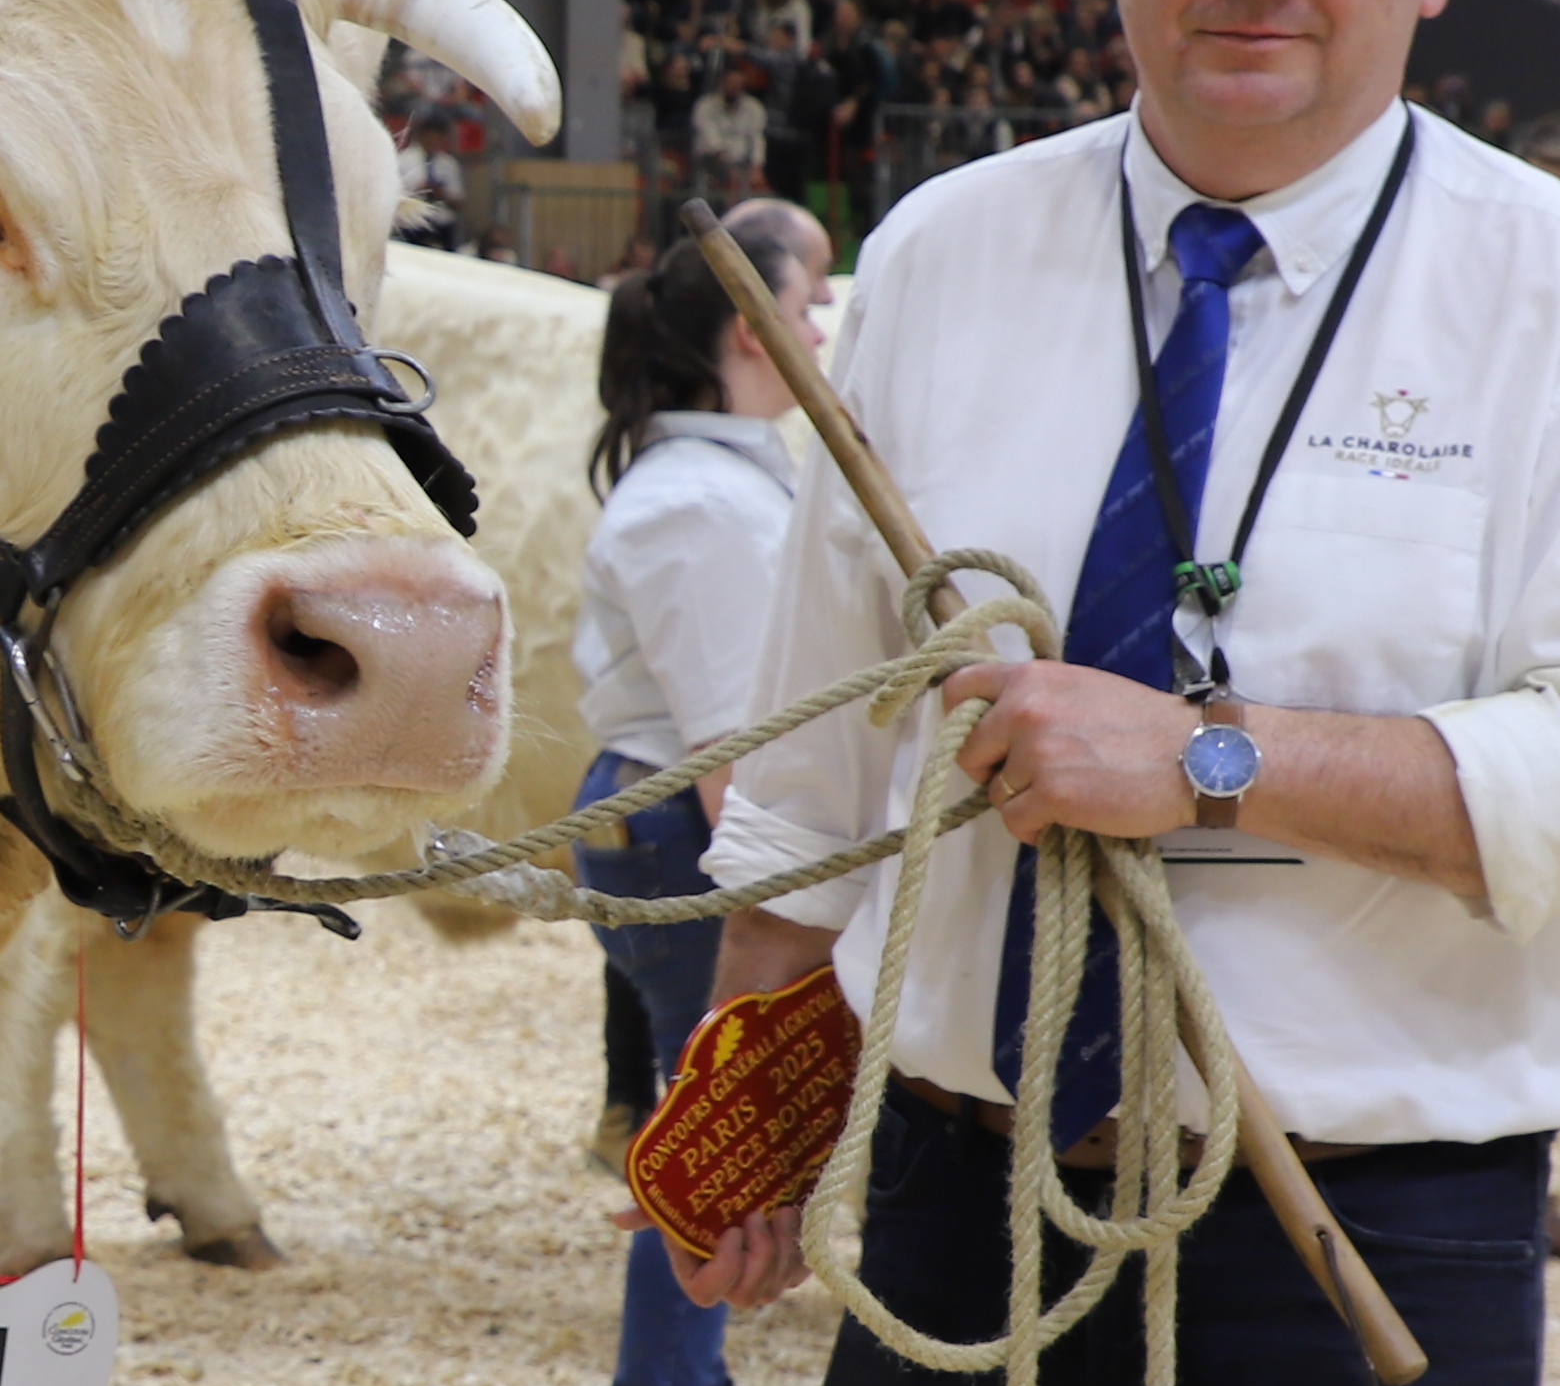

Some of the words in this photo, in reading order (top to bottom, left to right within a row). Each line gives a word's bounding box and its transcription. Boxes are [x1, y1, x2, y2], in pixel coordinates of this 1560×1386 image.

[1308, 435, 1332, 448] LA
[1342, 436, 1474, 458] CHAROLAISE
[1334, 450, 1377, 464] RACE
[638, 1094, 712, 1181] CONCOURS
[709, 1035, 776, 1101] GÉNÉRAL
[680, 1095, 758, 1178] PARIS
[770, 1031, 825, 1095] 2025
[688, 1132, 767, 1216] ESPÈCE
[763, 1057, 846, 1144] BOVINE
[718, 1107, 838, 1224] Participation
